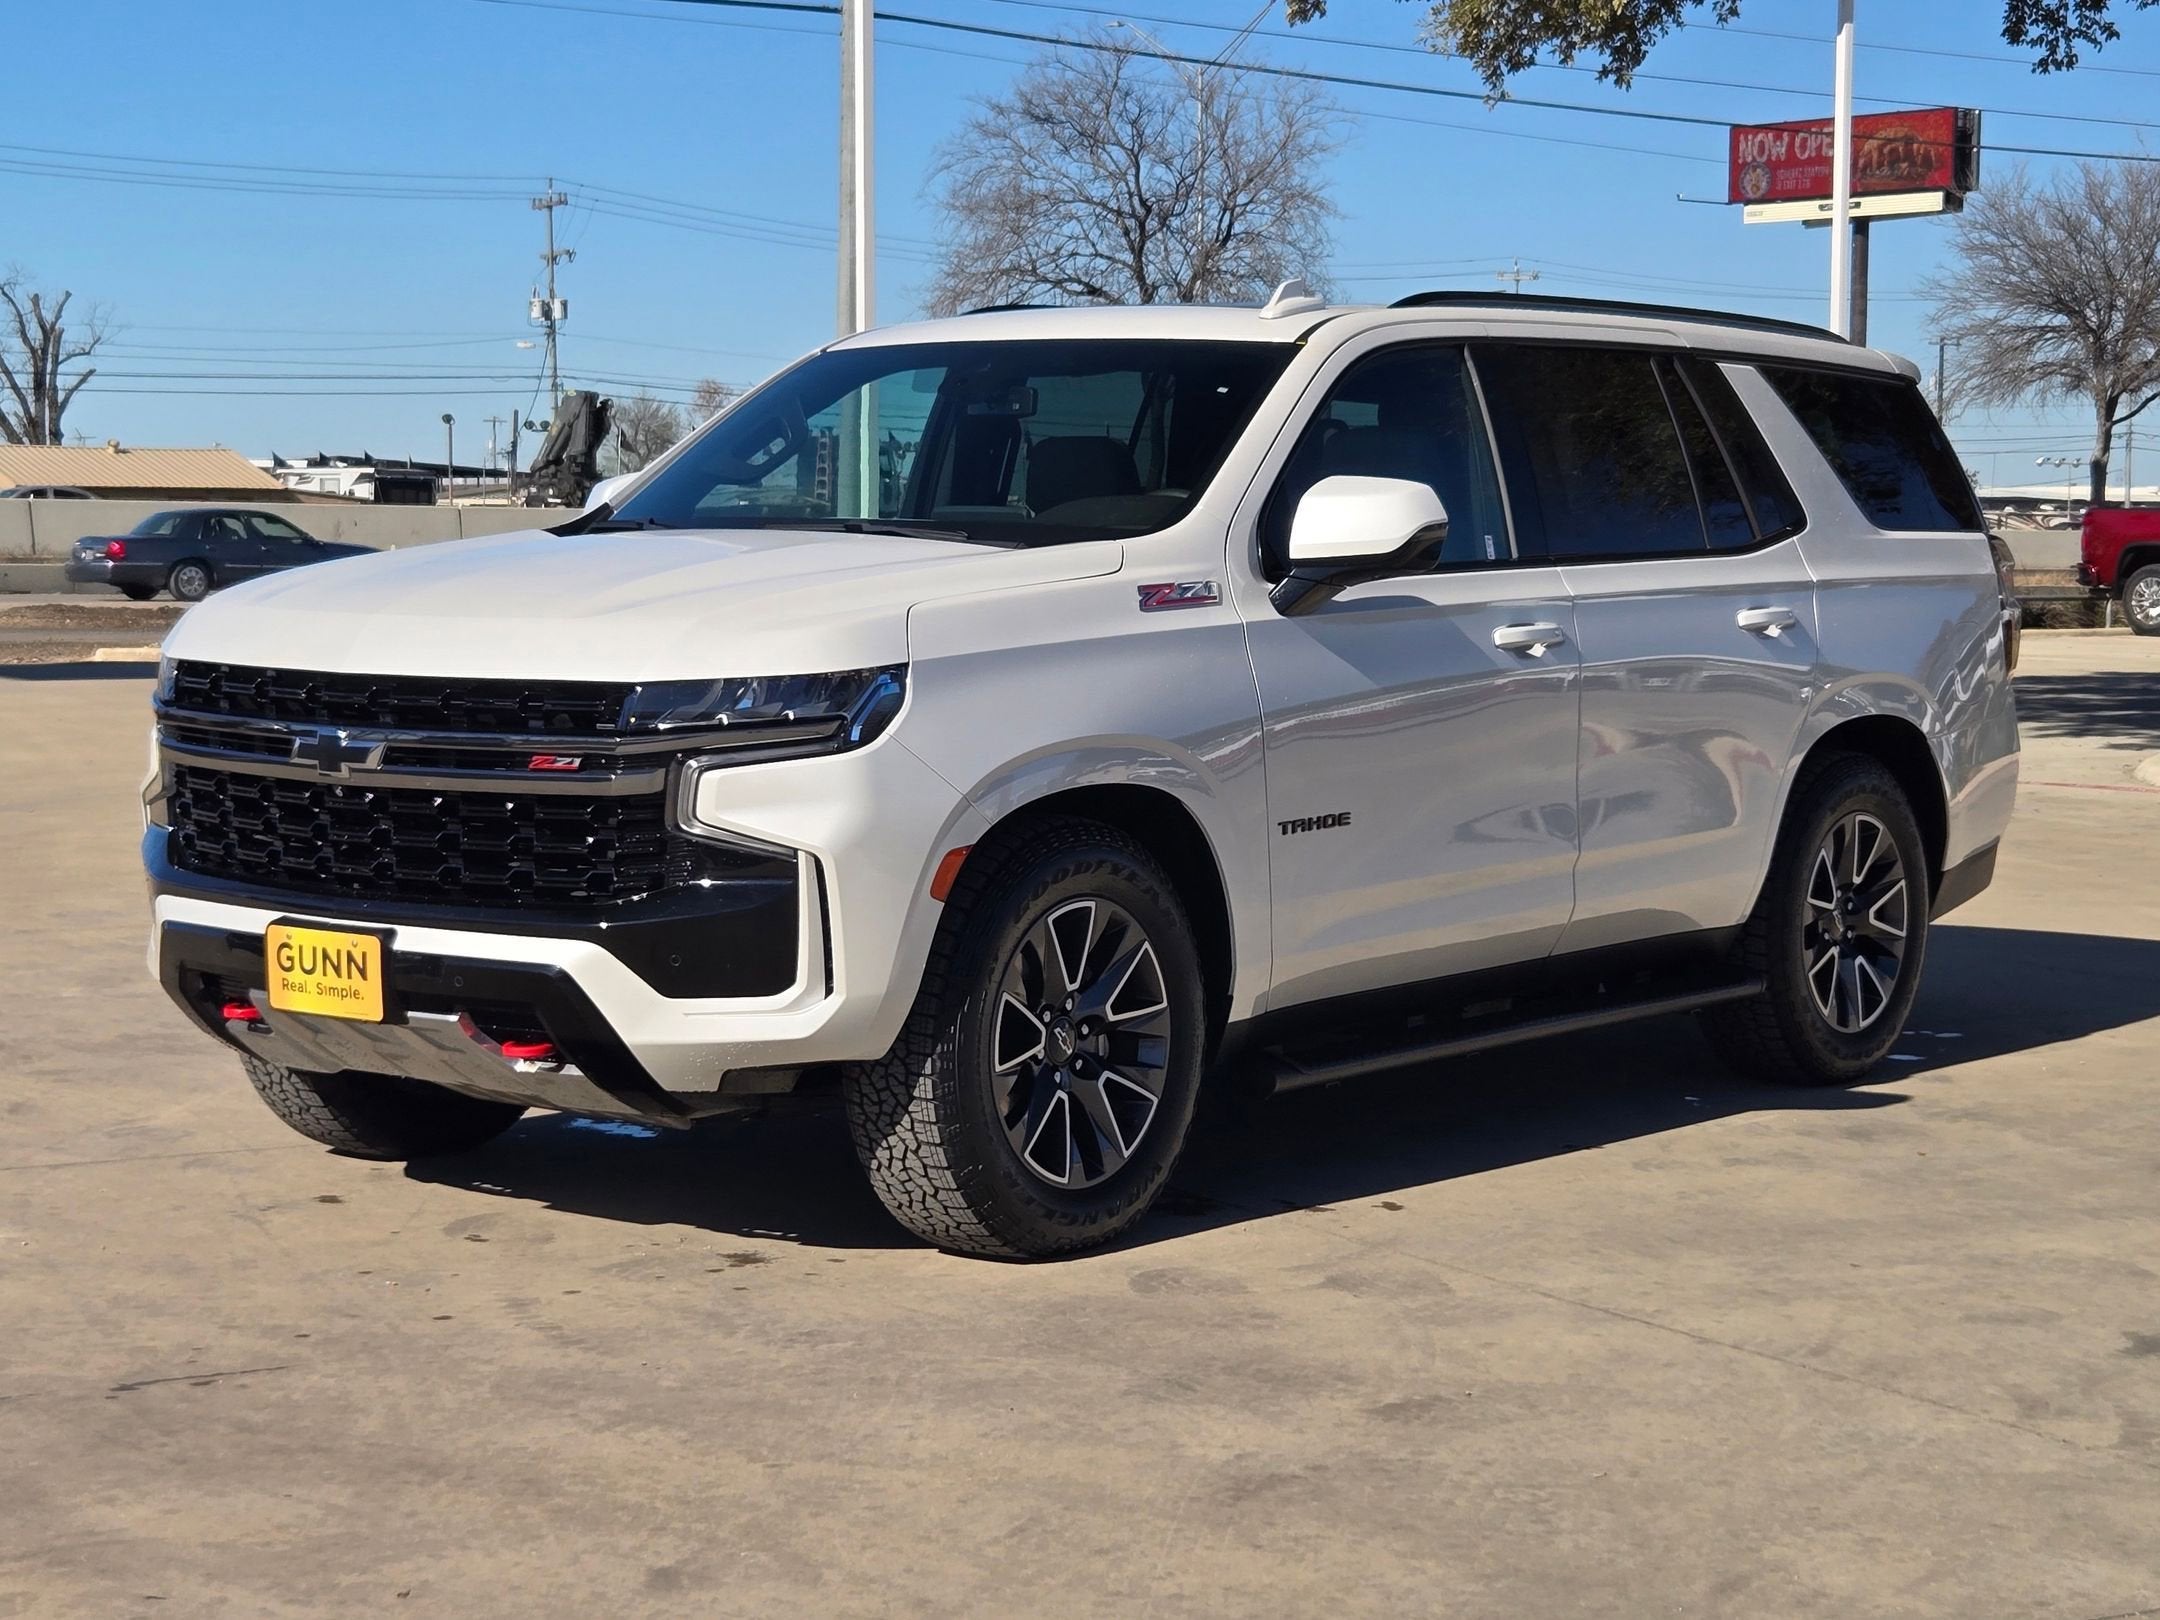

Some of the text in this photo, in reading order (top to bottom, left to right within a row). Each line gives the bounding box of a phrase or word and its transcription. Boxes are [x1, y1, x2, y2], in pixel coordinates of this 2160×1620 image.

[1738, 127, 1834, 164] NOW OPE
[1137, 581, 1223, 613] Z71
[528, 755, 582, 771] Z71
[1277, 811, 1352, 836] TAHOE
[277, 942, 368, 981] GUNN
[282, 978, 364, 1000] Real. Simple.
